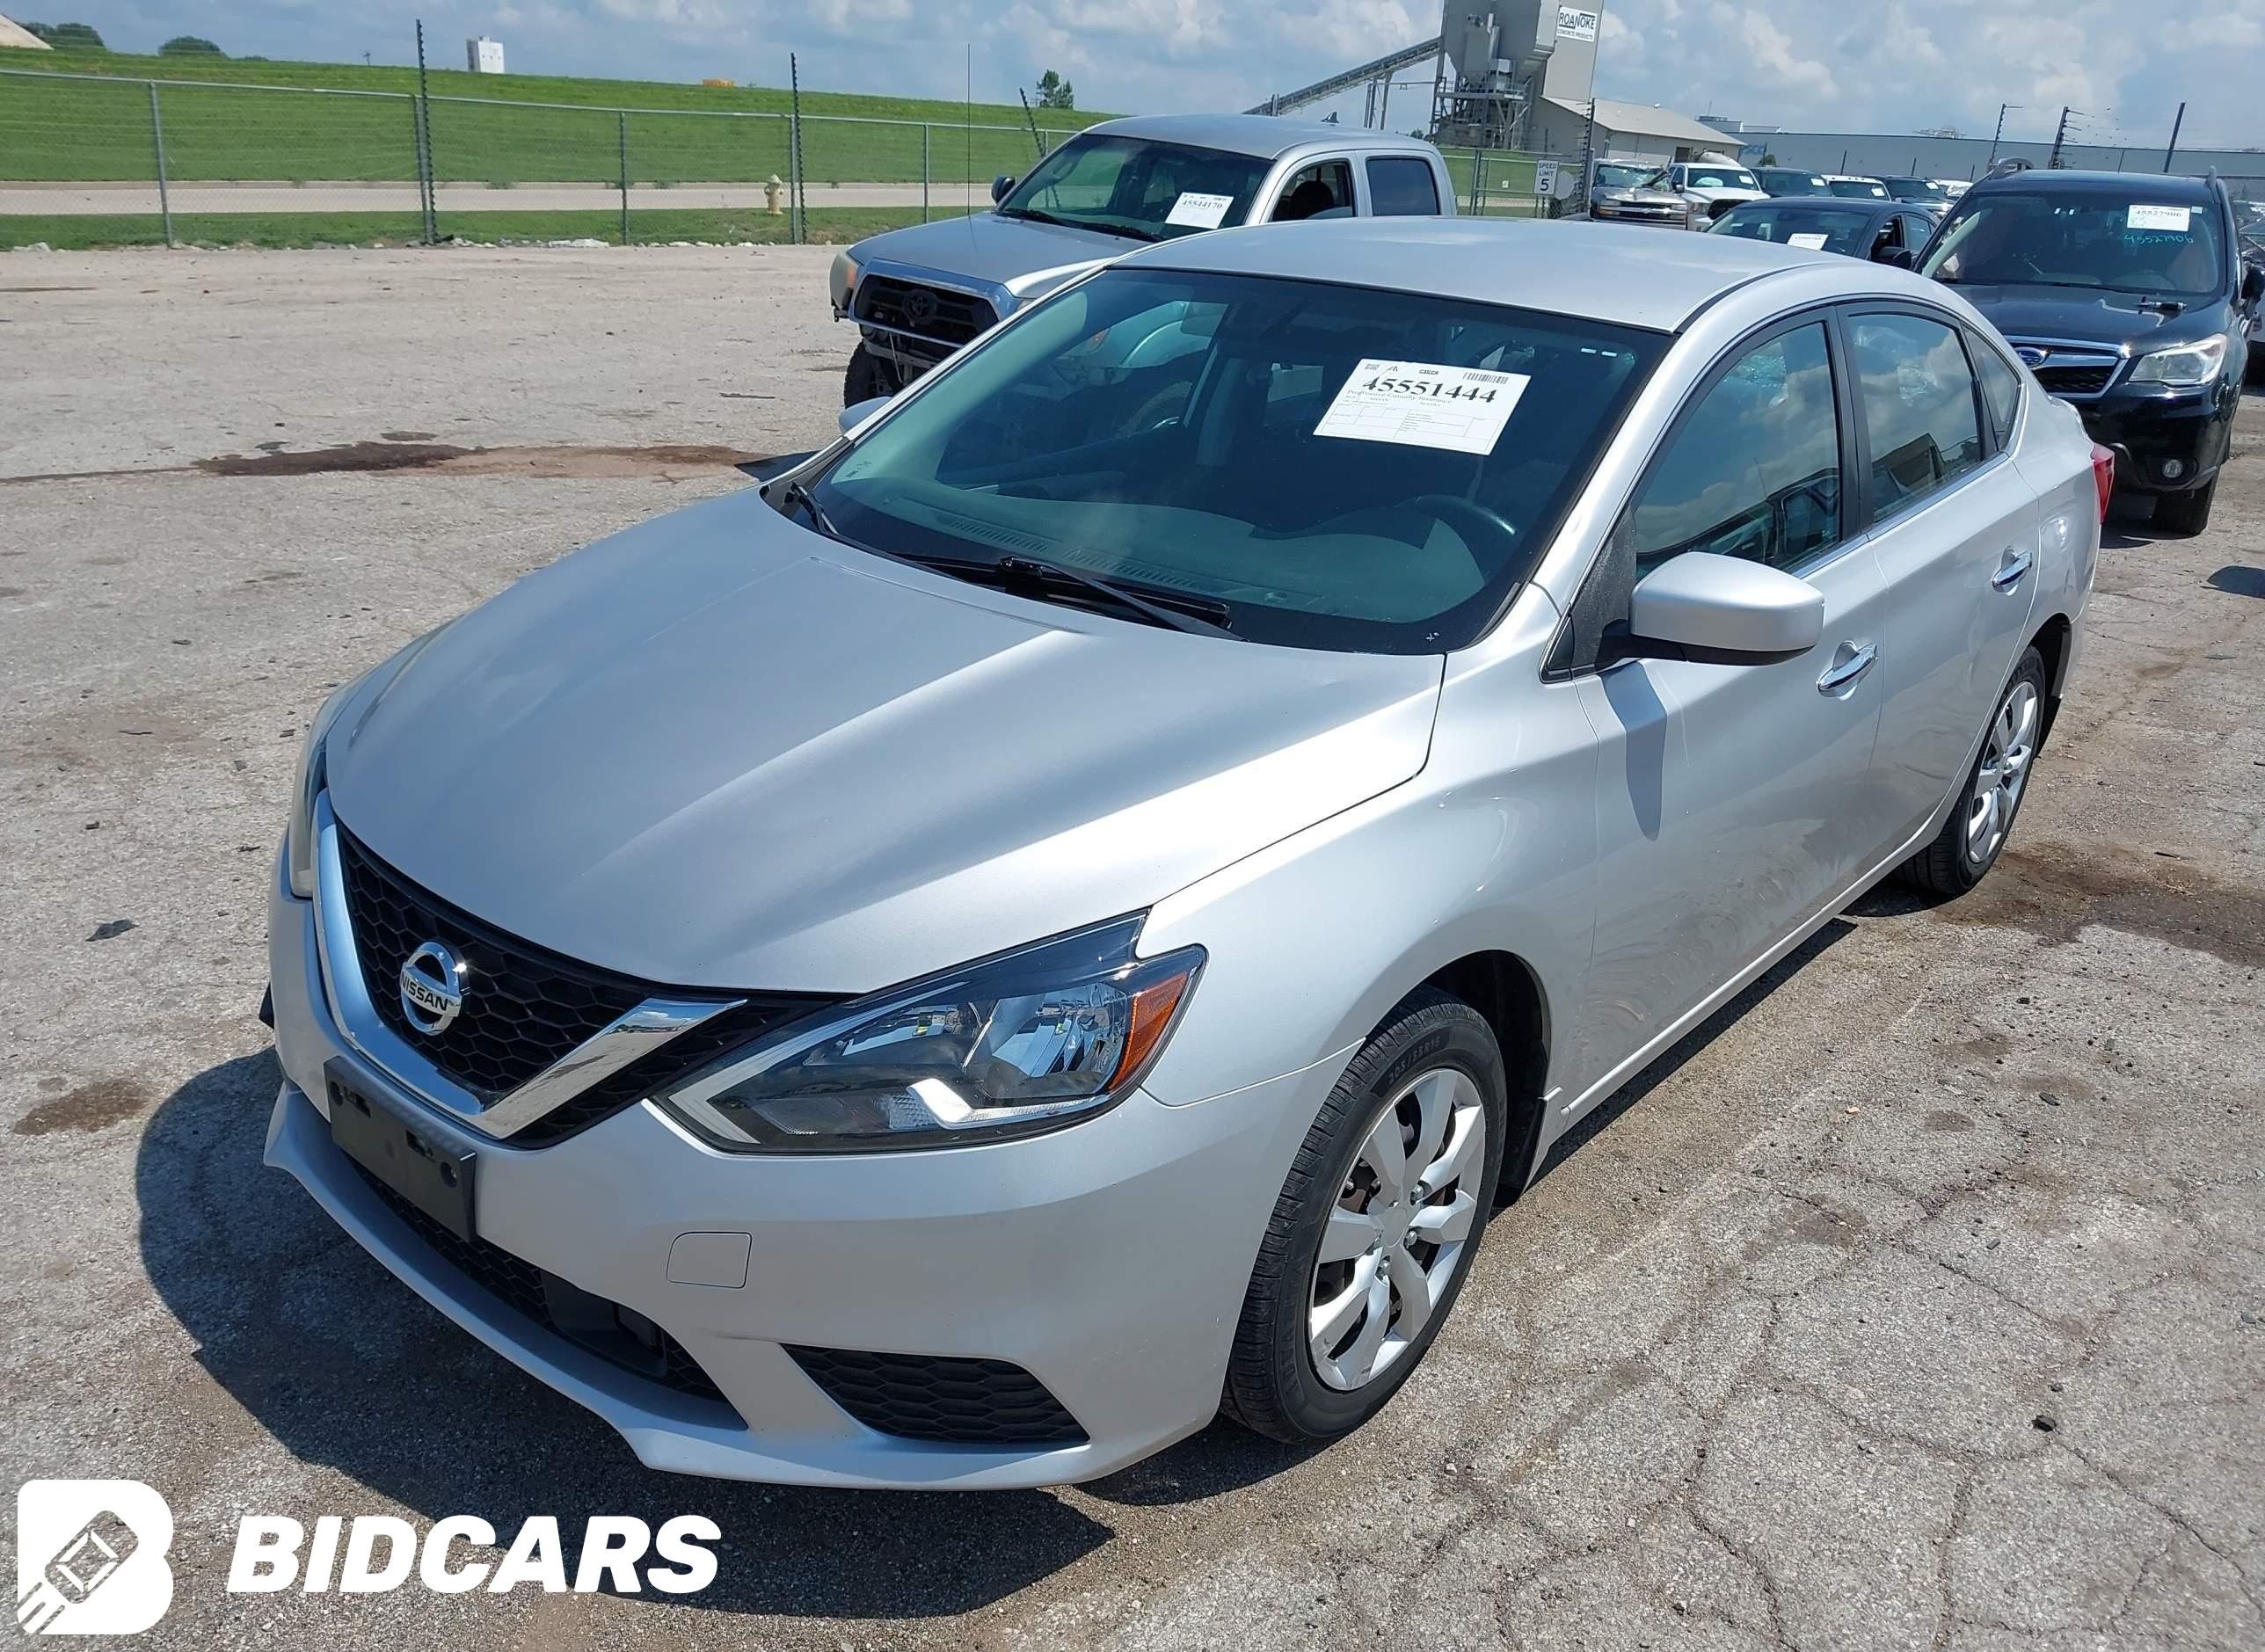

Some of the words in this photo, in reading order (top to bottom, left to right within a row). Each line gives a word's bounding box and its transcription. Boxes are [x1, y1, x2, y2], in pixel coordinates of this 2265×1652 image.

[1559, 12, 1595, 30] ROANOKE
[1540, 178, 1549, 192] 5
[1362, 376, 1497, 403] 45551444
[400, 974, 448, 1011] NISSAN
